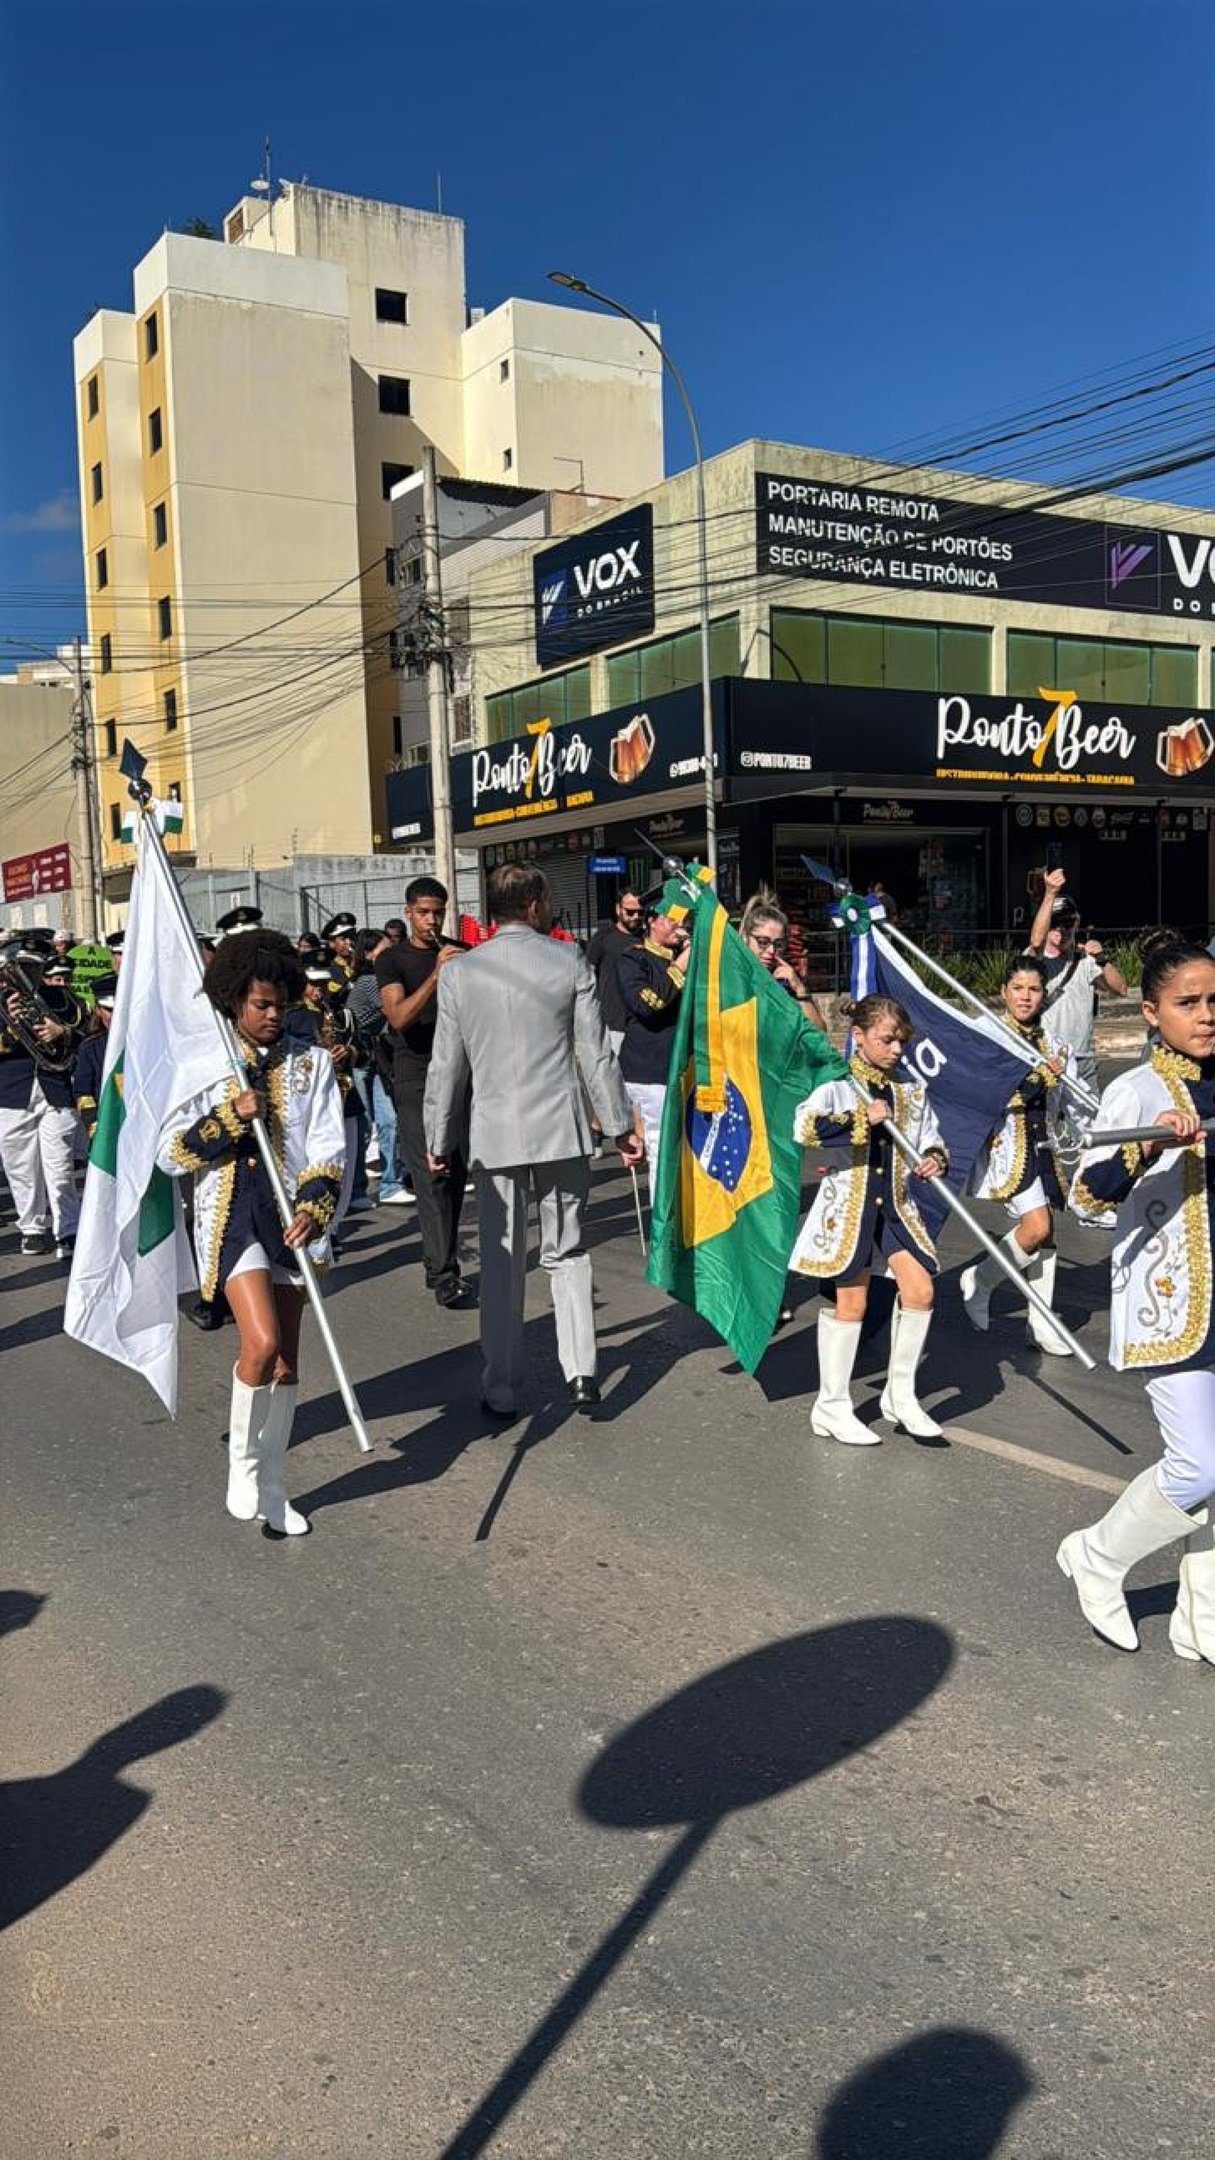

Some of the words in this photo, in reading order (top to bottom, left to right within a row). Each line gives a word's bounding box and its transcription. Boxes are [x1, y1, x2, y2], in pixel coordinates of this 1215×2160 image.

[768, 480, 862, 511] PORTARIA
[866, 495, 940, 522] REMOTA
[768, 513, 899, 549] MANUTENÇÃO
[932, 536, 1013, 561] PORTÕES
[573, 540, 642, 599] VOX
[768, 545, 886, 579] SEGURANÇA
[890, 560, 998, 590] ELETRÔNICA
[1167, 534, 1215, 588] V
[1173, 598, 1201, 613] DO
[74, 958, 112, 969] IDADE
